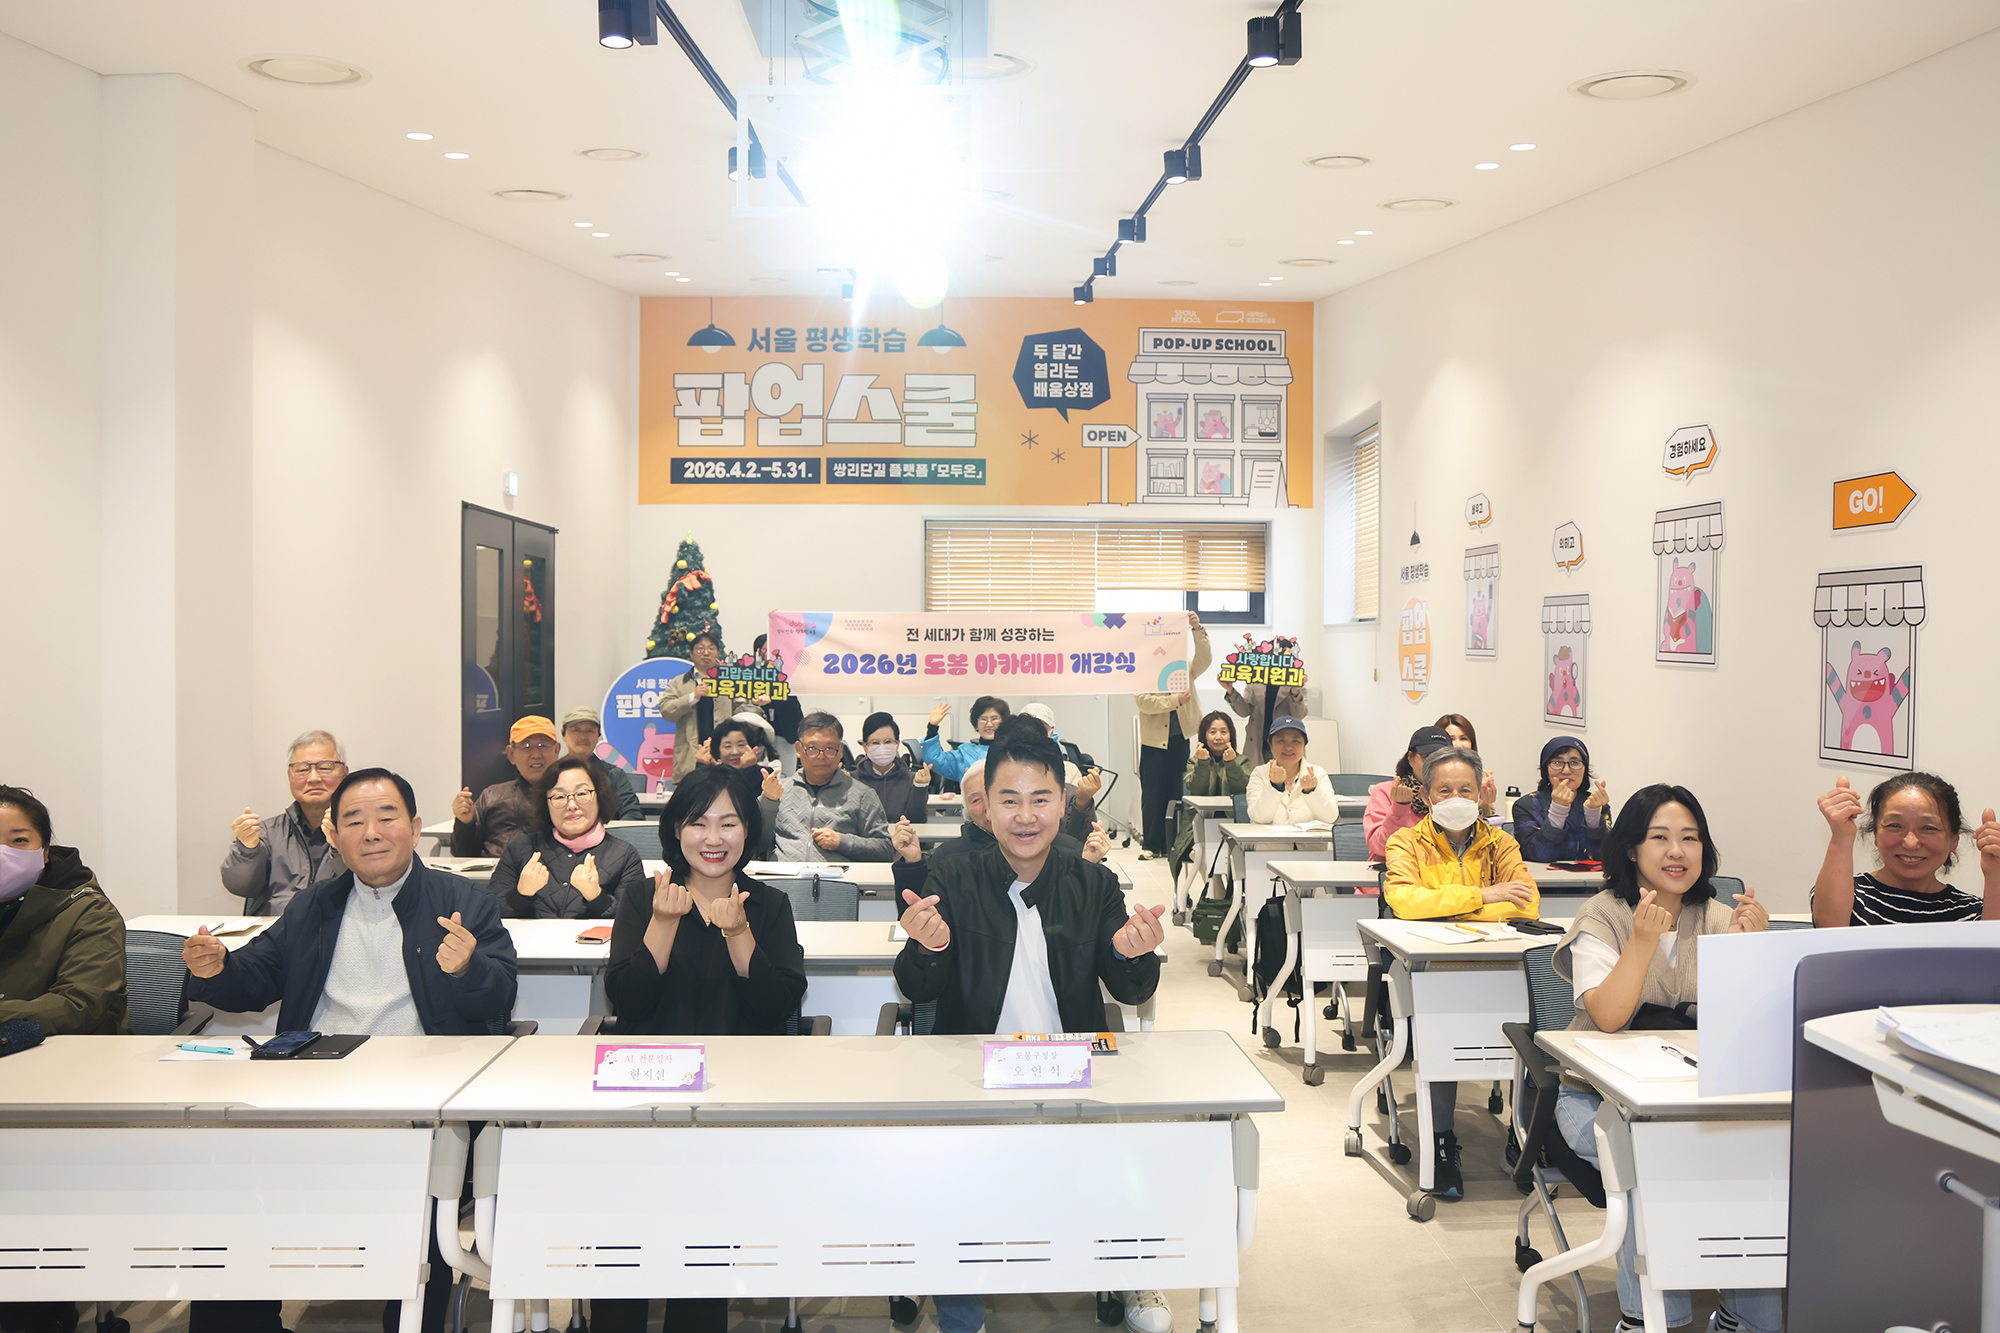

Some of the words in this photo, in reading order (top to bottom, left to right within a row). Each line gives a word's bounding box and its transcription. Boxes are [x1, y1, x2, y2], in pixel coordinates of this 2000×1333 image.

[747, 327, 798, 353] 서울
[805, 327, 907, 353] 평생학습
[1153, 336, 1213, 351] POP-UP
[1215, 338, 1276, 352] SCHOOL
[1033, 344, 1048, 360] 두
[1051, 343, 1082, 360] 달간
[1033, 362, 1079, 379] 열리는
[1033, 381, 1094, 398] 배움상점
[673, 362, 978, 447] 팝업스쿨
[1087, 430, 1127, 442] OPEN
[1670, 436, 1706, 459] 경험하세요
[833, 462, 886, 478] 쌍리단길
[889, 462, 929, 478] 플랫폼
[1848, 486, 1884, 515] GO!
[1402, 601, 1427, 646] 팝업
[906, 628, 920, 642] 전
[924, 628, 965, 642] 세대가
[969, 628, 997, 642] 함께
[1000, 628, 1055, 642] 성장하는
[823, 653, 917, 676] 2026년
[924, 653, 969, 676] 도봉
[975, 652, 1064, 676] 아카데미
[1070, 651, 1136, 675] 개강식
[1236, 653, 1294, 668] 사랑합니다
[718, 666, 777, 682] 고맙습니다
[1219, 664, 1304, 687] 교육지원과
[1402, 653, 1427, 692] 스쿨
[635, 678, 656, 689] 서울
[623, 1054, 634, 1063] AI
[639, 1054, 673, 1063] 전문강사
[1015, 1051, 1058, 1060] 도봉구청장
[630, 1068, 665, 1081] 한지선
